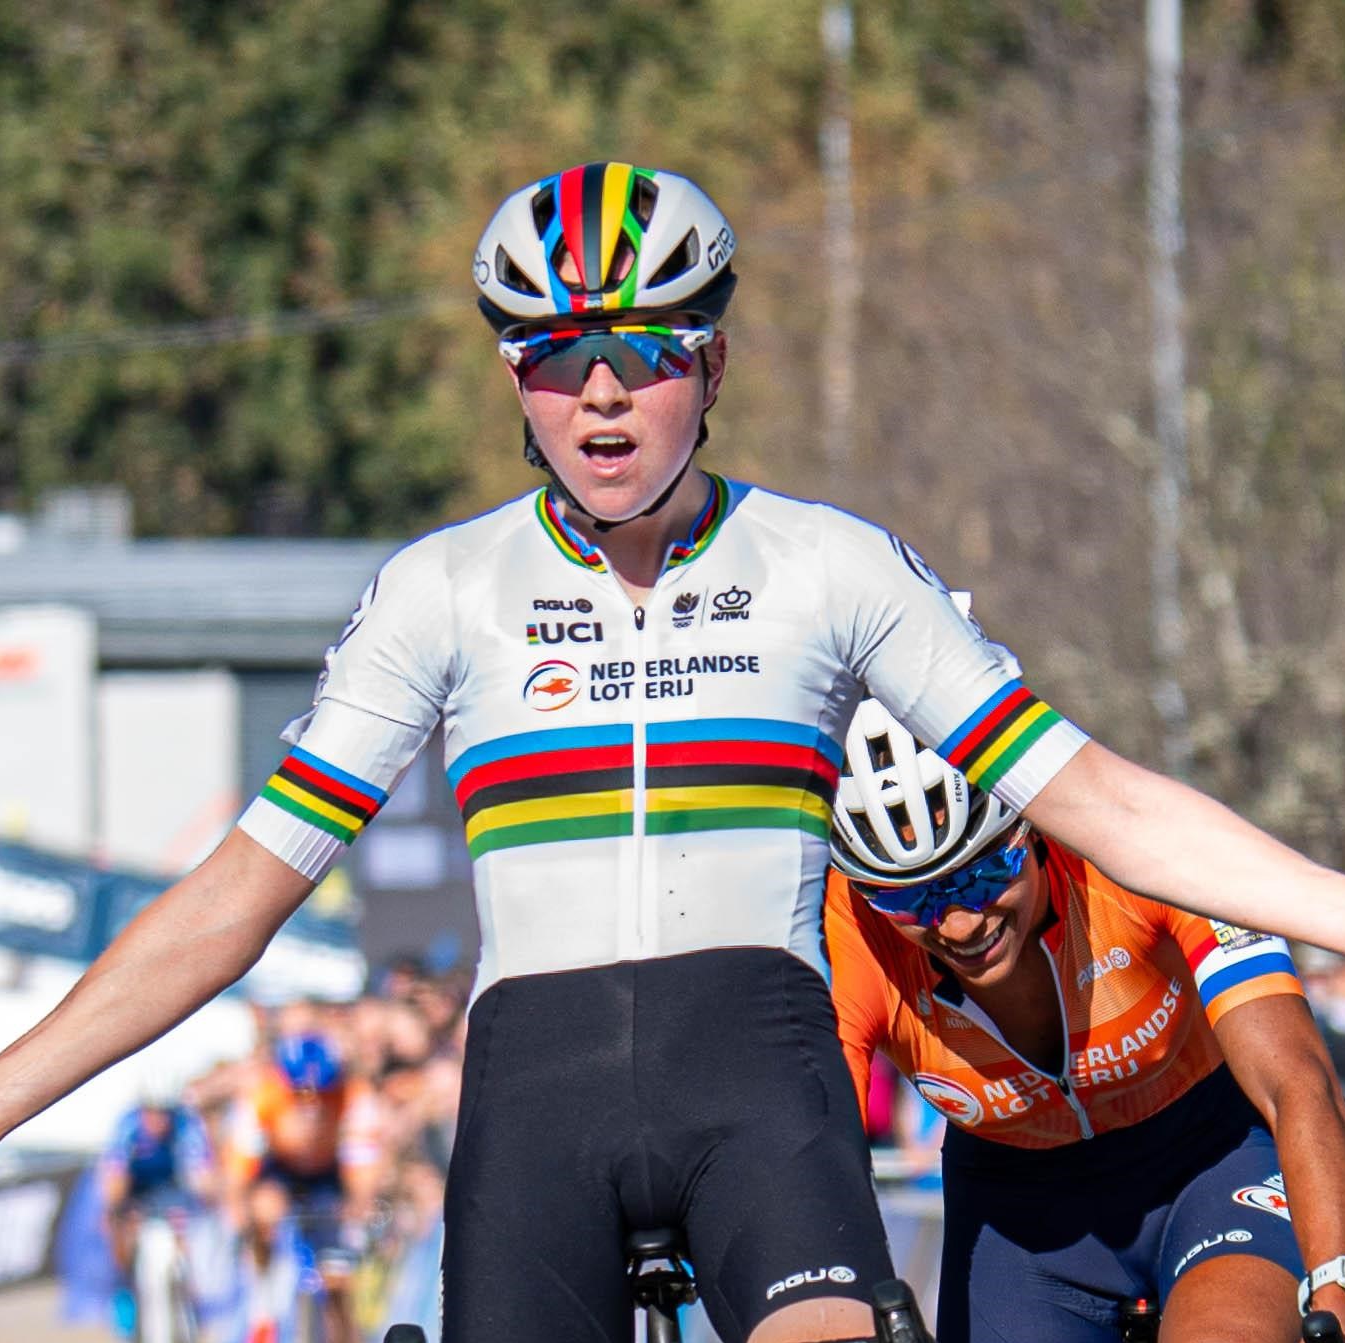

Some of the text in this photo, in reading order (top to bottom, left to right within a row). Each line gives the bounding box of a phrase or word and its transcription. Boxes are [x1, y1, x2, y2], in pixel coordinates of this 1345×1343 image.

[533, 600, 574, 611] AGU
[540, 622, 604, 645] UCI
[1175, 1233, 1224, 1277] AGU
[767, 1268, 828, 1300] AGU
